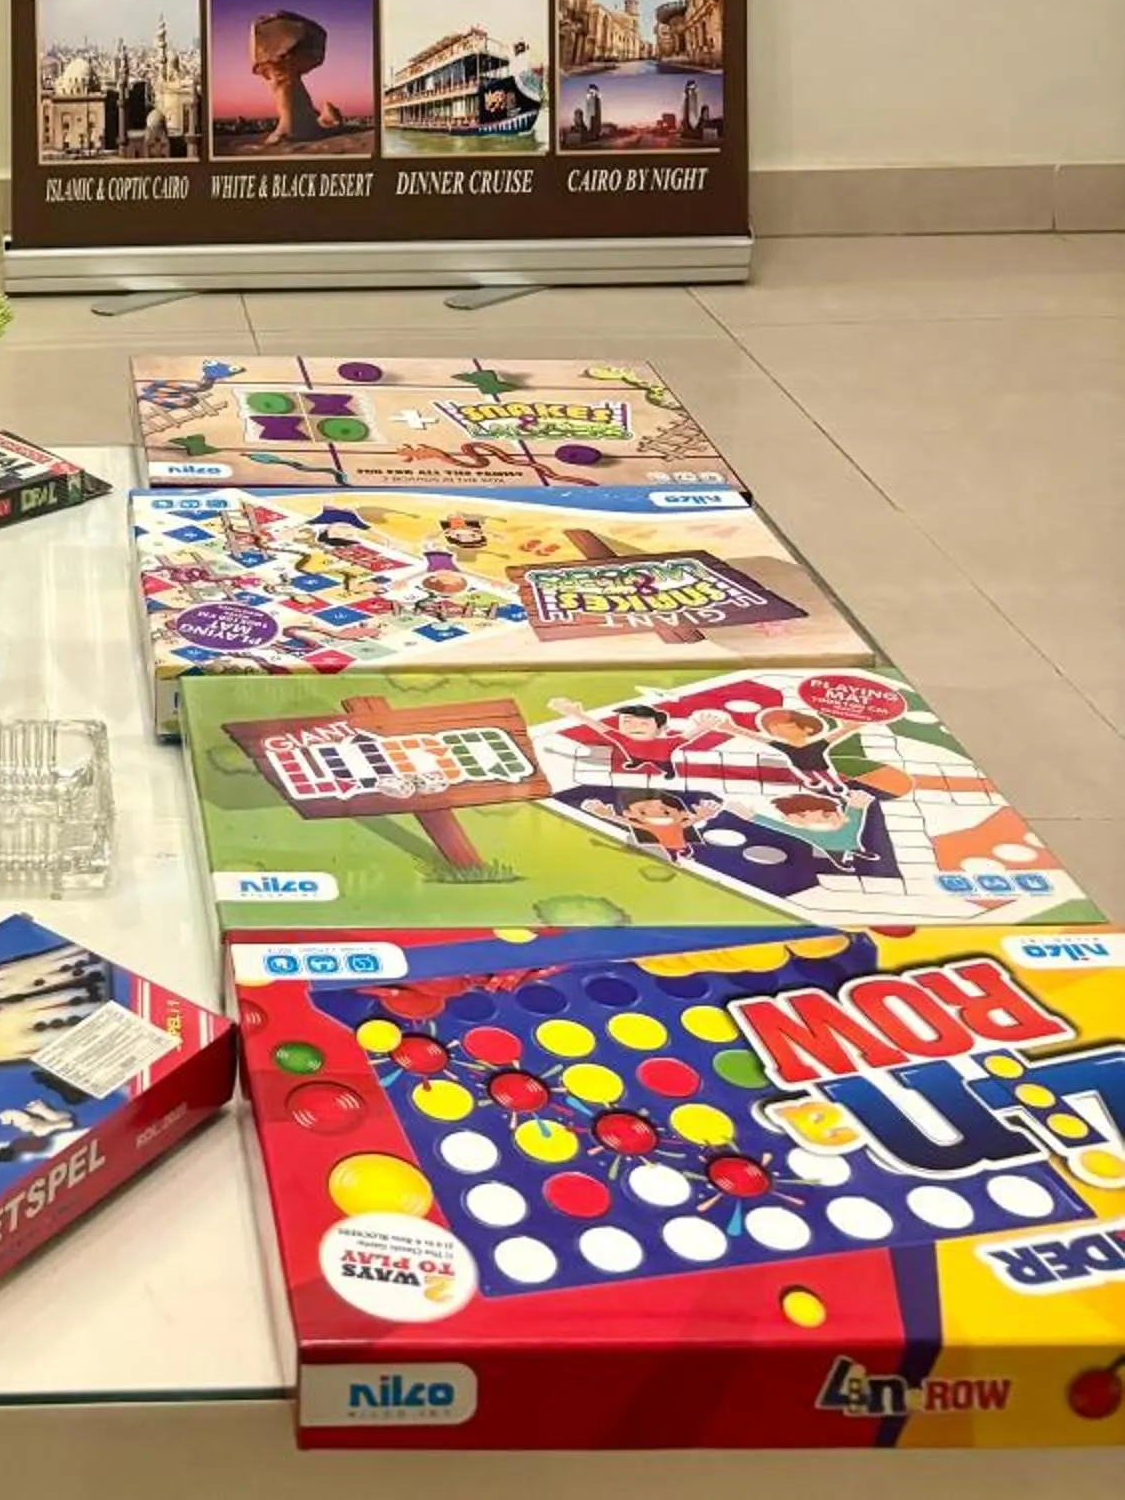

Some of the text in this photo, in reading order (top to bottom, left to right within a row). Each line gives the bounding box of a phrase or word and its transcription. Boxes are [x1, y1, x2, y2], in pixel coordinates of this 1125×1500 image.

[46, 176, 189, 202] ISLAMIC & COPTIC CAIRO
[210, 173, 374, 199] WHITE & BLACK DESERT
[395, 169, 534, 195] DINNER CRUISE
[567, 167, 709, 192] CAIRO BY NIGHT
[559, 581, 727, 612] SNAKES
[604, 611, 726, 629] GIANT
[811, 680, 898, 701] PLAYING
[265, 721, 357, 754] GIANT
[740, 963, 1068, 1084] ROW
[341, 1250, 455, 1276] TO PLAY
[989, 1232, 1125, 1286] DER
[342, 1264, 454, 1303] 2 WAYS
[350, 1374, 454, 1408] nilco
[925, 1381, 1012, 1411] ROW
